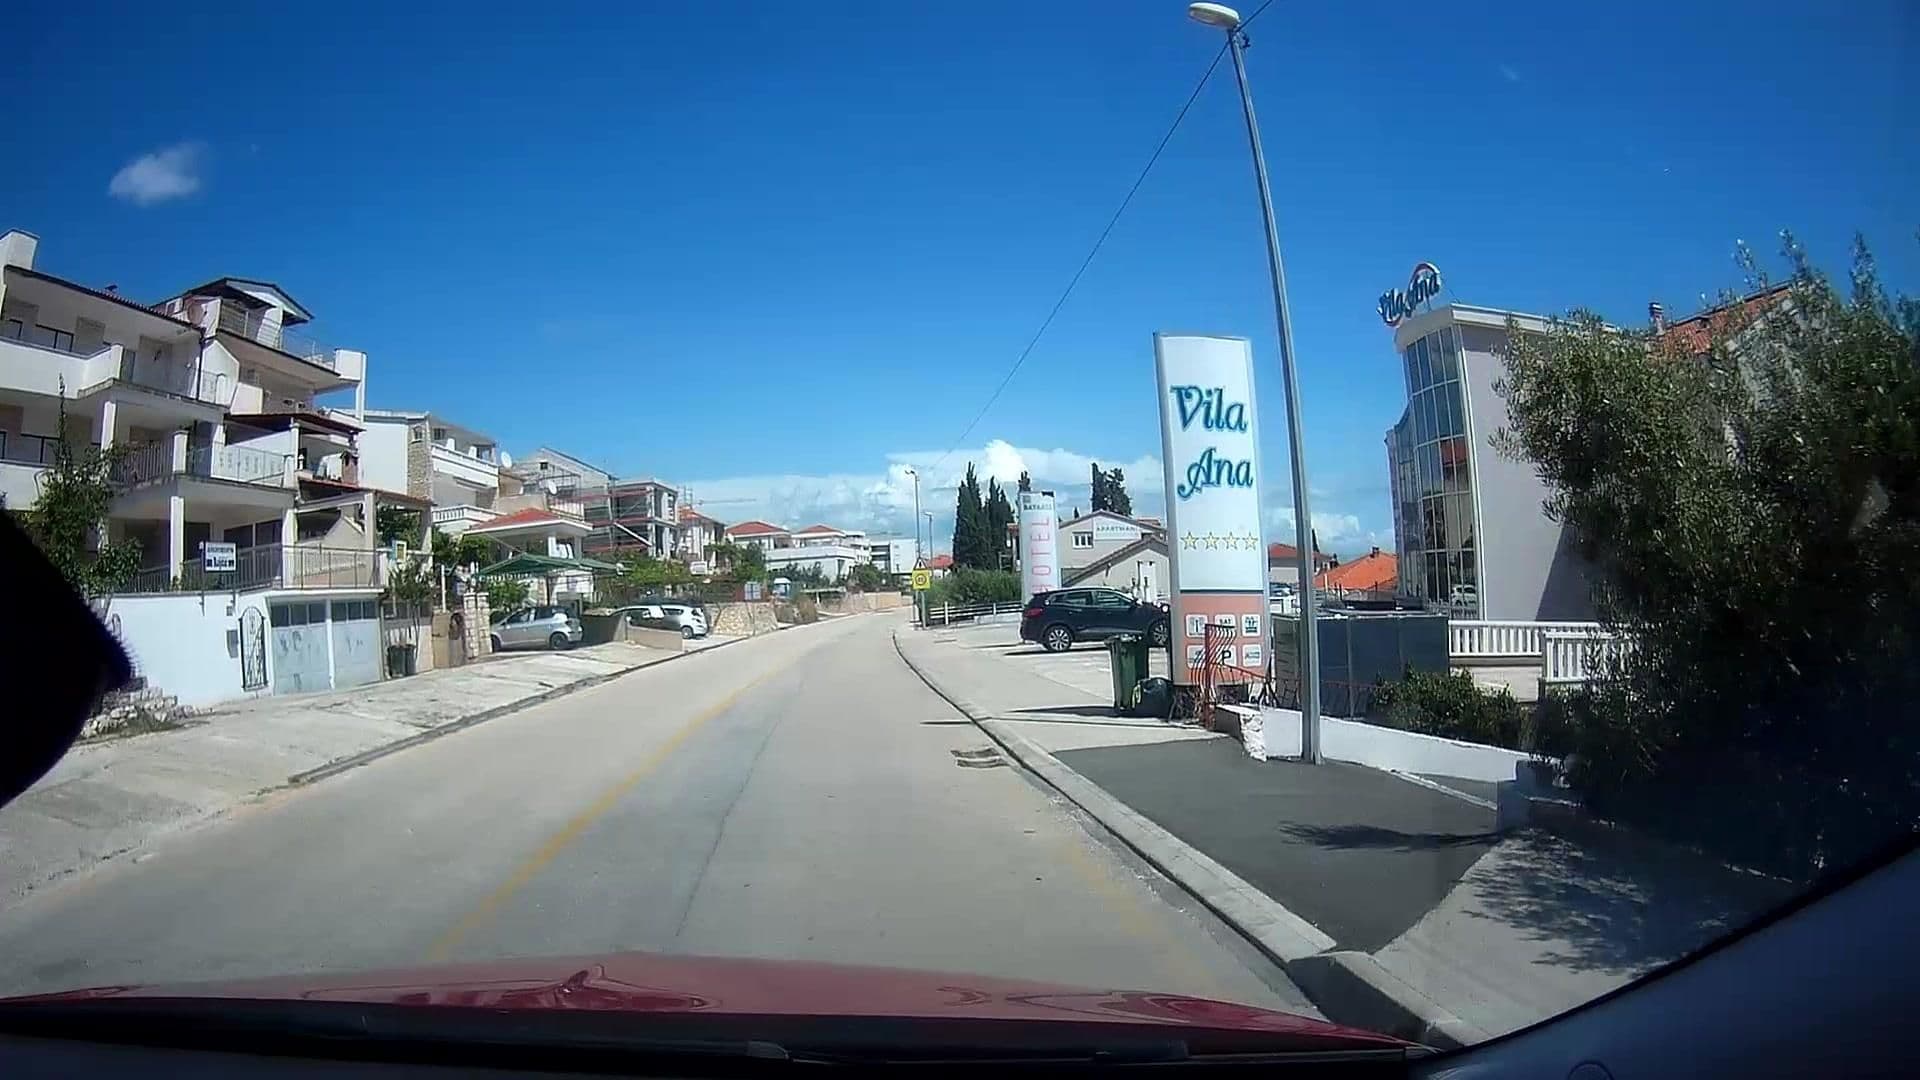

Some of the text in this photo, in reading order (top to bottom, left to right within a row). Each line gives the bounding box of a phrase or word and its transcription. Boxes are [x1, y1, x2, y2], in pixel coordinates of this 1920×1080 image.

[1405, 269, 1440, 317] Ana
[1170, 385, 1247, 433] Vila
[1177, 446, 1253, 500] Ana
